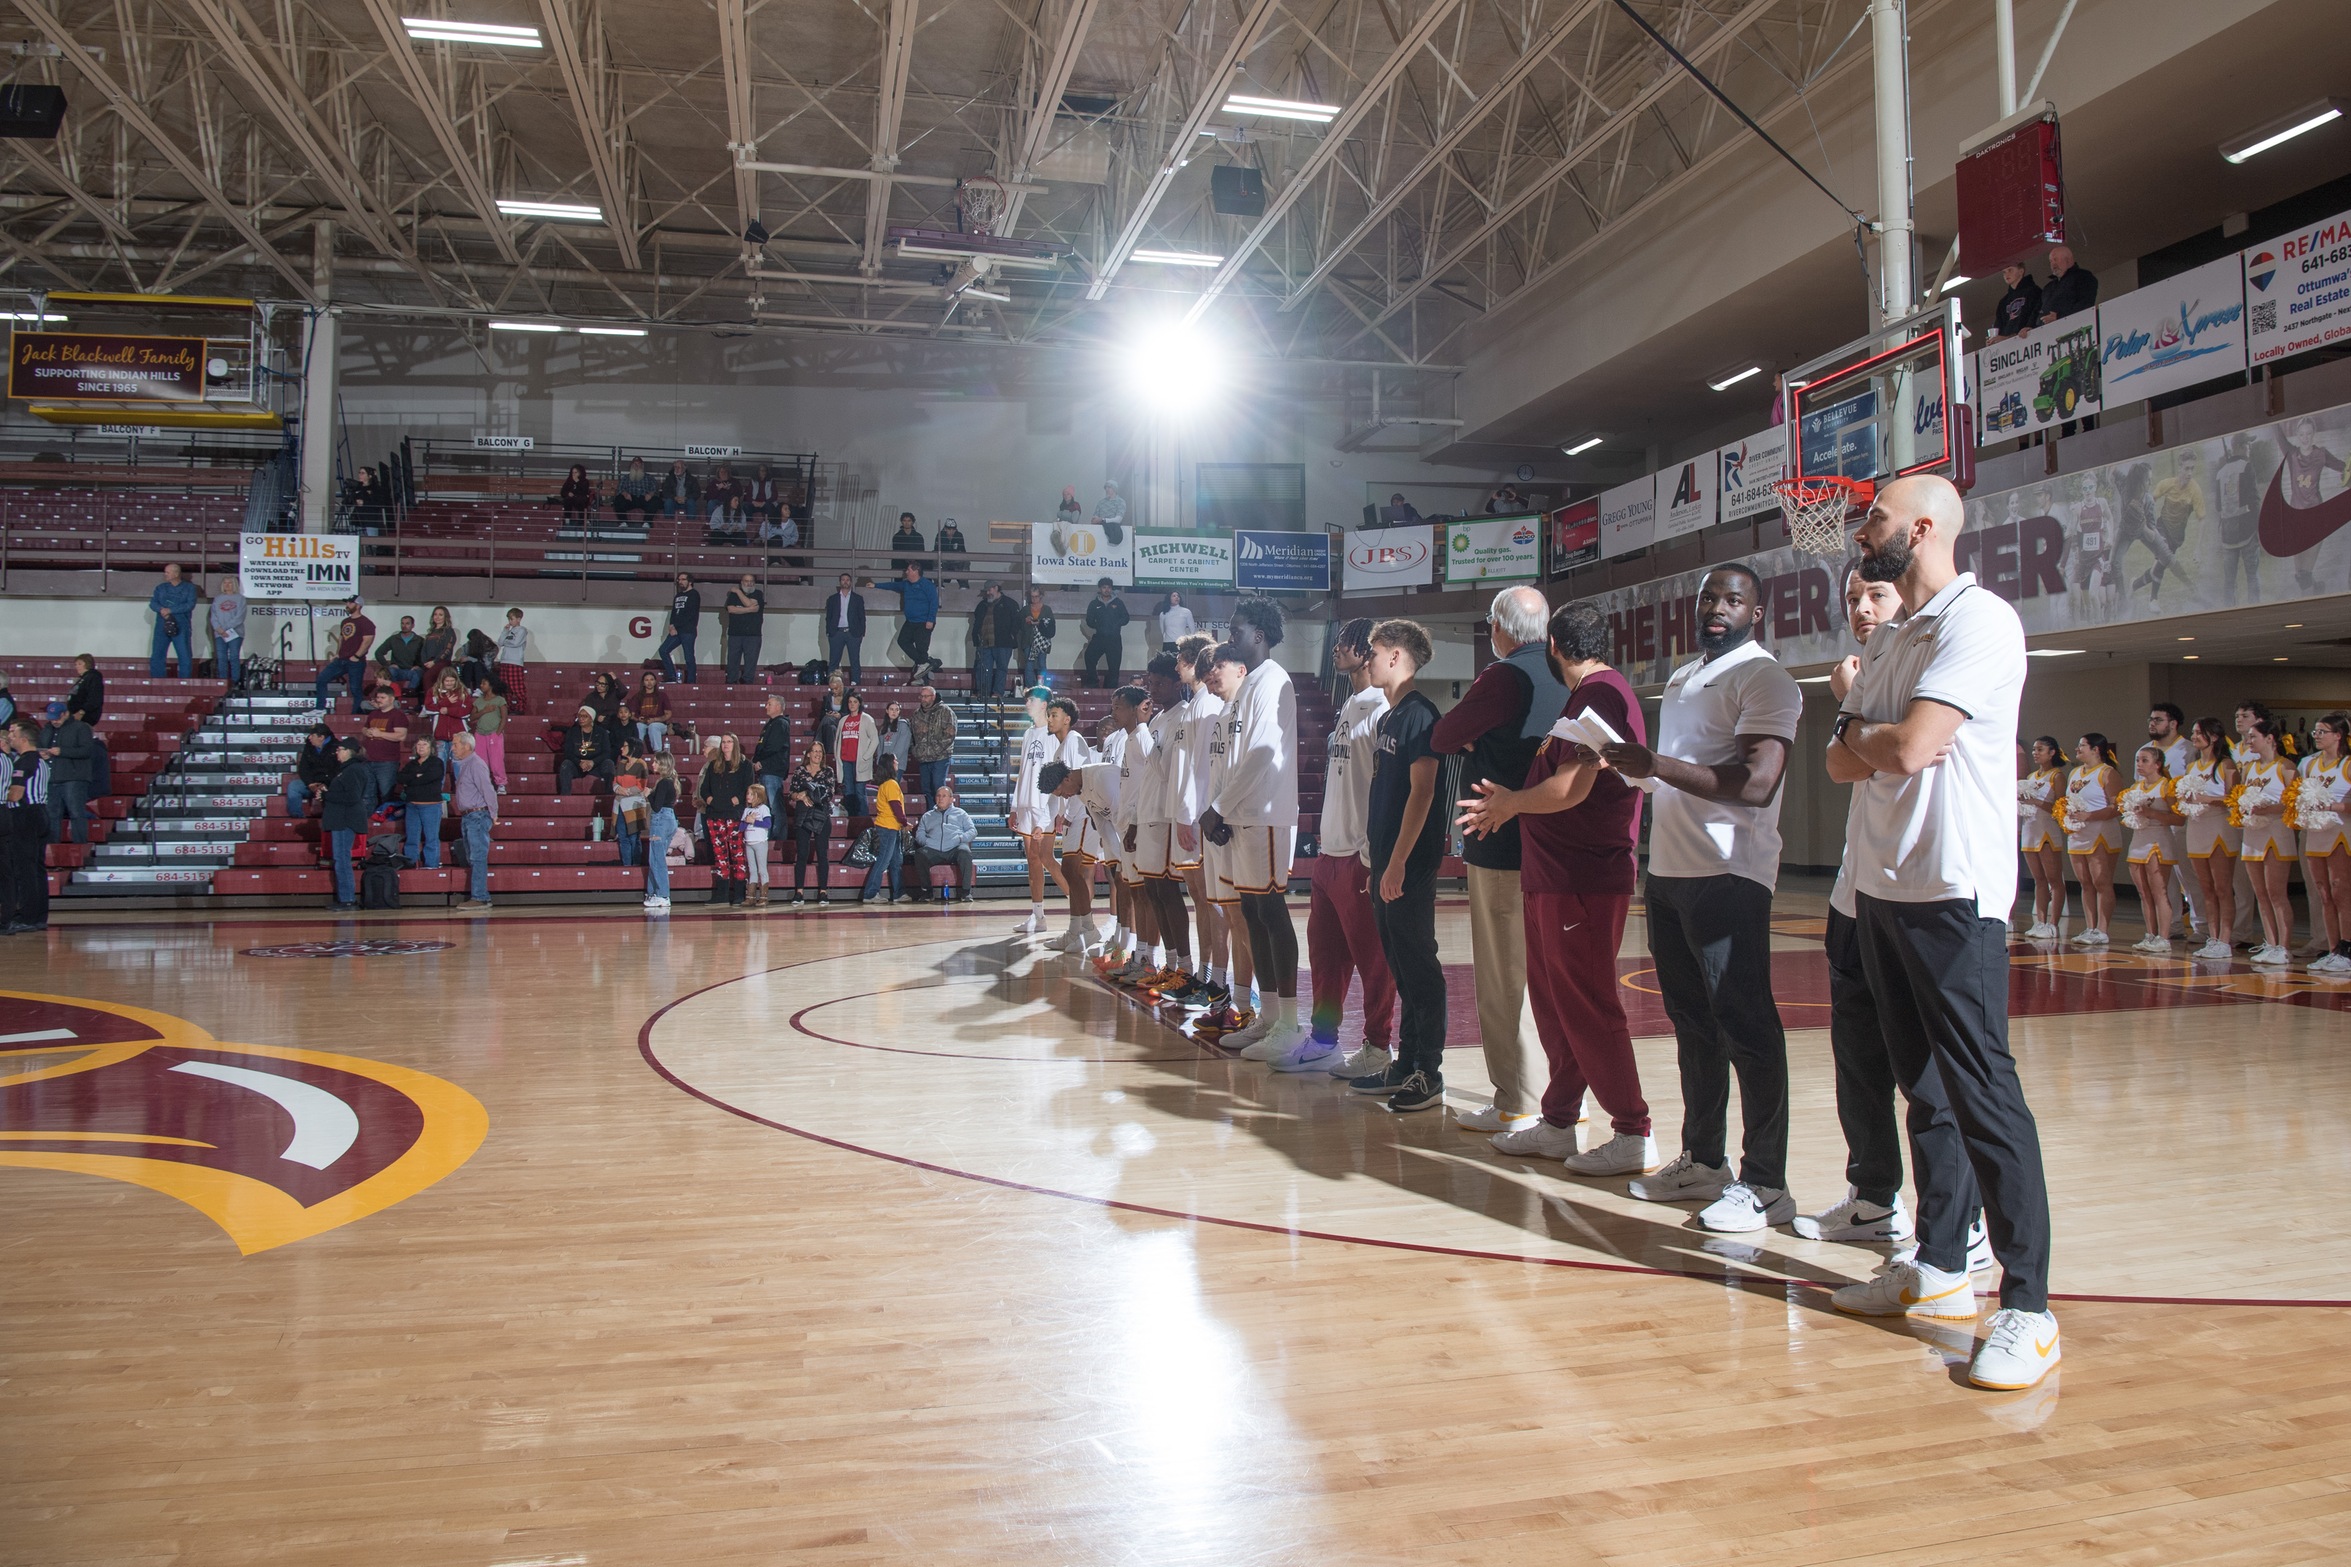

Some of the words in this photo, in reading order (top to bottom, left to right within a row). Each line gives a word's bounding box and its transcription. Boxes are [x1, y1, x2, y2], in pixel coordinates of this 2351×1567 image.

[1976, 133, 2016, 159] DAKTRONICS
[2297, 268, 2351, 295] Ottumwa'
[2290, 298, 2312, 315] Real
[2316, 288, 2350, 306] Estate
[2284, 322, 2298, 332] 2437
[2300, 312, 2332, 327] Northgate
[2338, 306, 2351, 316] Nex
[2102, 328, 2150, 365] Polar
[2254, 346, 2286, 361] Locally
[2288, 334, 2322, 351] Owned,
[21, 344, 57, 365] Jack
[61, 344, 135, 364] Blackwell
[139, 348, 195, 372] Family
[1990, 342, 2041, 373] SINCLAIR
[34, 368, 106, 379] SUPPORTING
[108, 370, 148, 381] INDIAN
[150, 371, 181, 381] HILLS
[77, 382, 110, 392] SINCE
[112, 383, 138, 393] 1965
[1823, 403, 1858, 424] BELLEVUE
[101, 425, 144, 434] BALCONY
[150, 426, 156, 434] F
[477, 438, 519, 447] BALCONY
[523, 439, 531, 448] G
[688, 446, 728, 456] BALCONY
[732, 447, 739, 456] H
[1813, 441, 1858, 464] Acceleate.
[1749, 453, 1761, 463] RIVER
[1731, 480, 1781, 506] 641-684-63
[1602, 508, 1627, 526] GREGG
[1627, 499, 1653, 518] YOUNG
[1629, 517, 1653, 528] OTTUMWA
[246, 537, 263, 545] GO
[263, 537, 335, 558] Hills
[335, 551, 350, 559] TV
[1139, 543, 1229, 561] RICHWELL
[1265, 544, 1314, 557] Meridian
[1037, 555, 1065, 566] Iowa
[1068, 555, 1096, 567] State
[1100, 557, 1128, 568] Bank
[1148, 557, 1177, 565] CARPET
[1360, 546, 1412, 565] JBS
[1452, 557, 1475, 565] Trusted
[1515, 554, 1535, 562] years.
[307, 564, 351, 581] IMN
[252, 607, 309, 616] RESERVED
[628, 616, 652, 639] G
[244, 755, 293, 763] 684-5151
[229, 777, 279, 785] 684-5151
[212, 799, 265, 807] 684-5151
[194, 822, 248, 830] 684-5151
[175, 846, 230, 854] 684-5151
[156, 872, 212, 881] 684-5151
